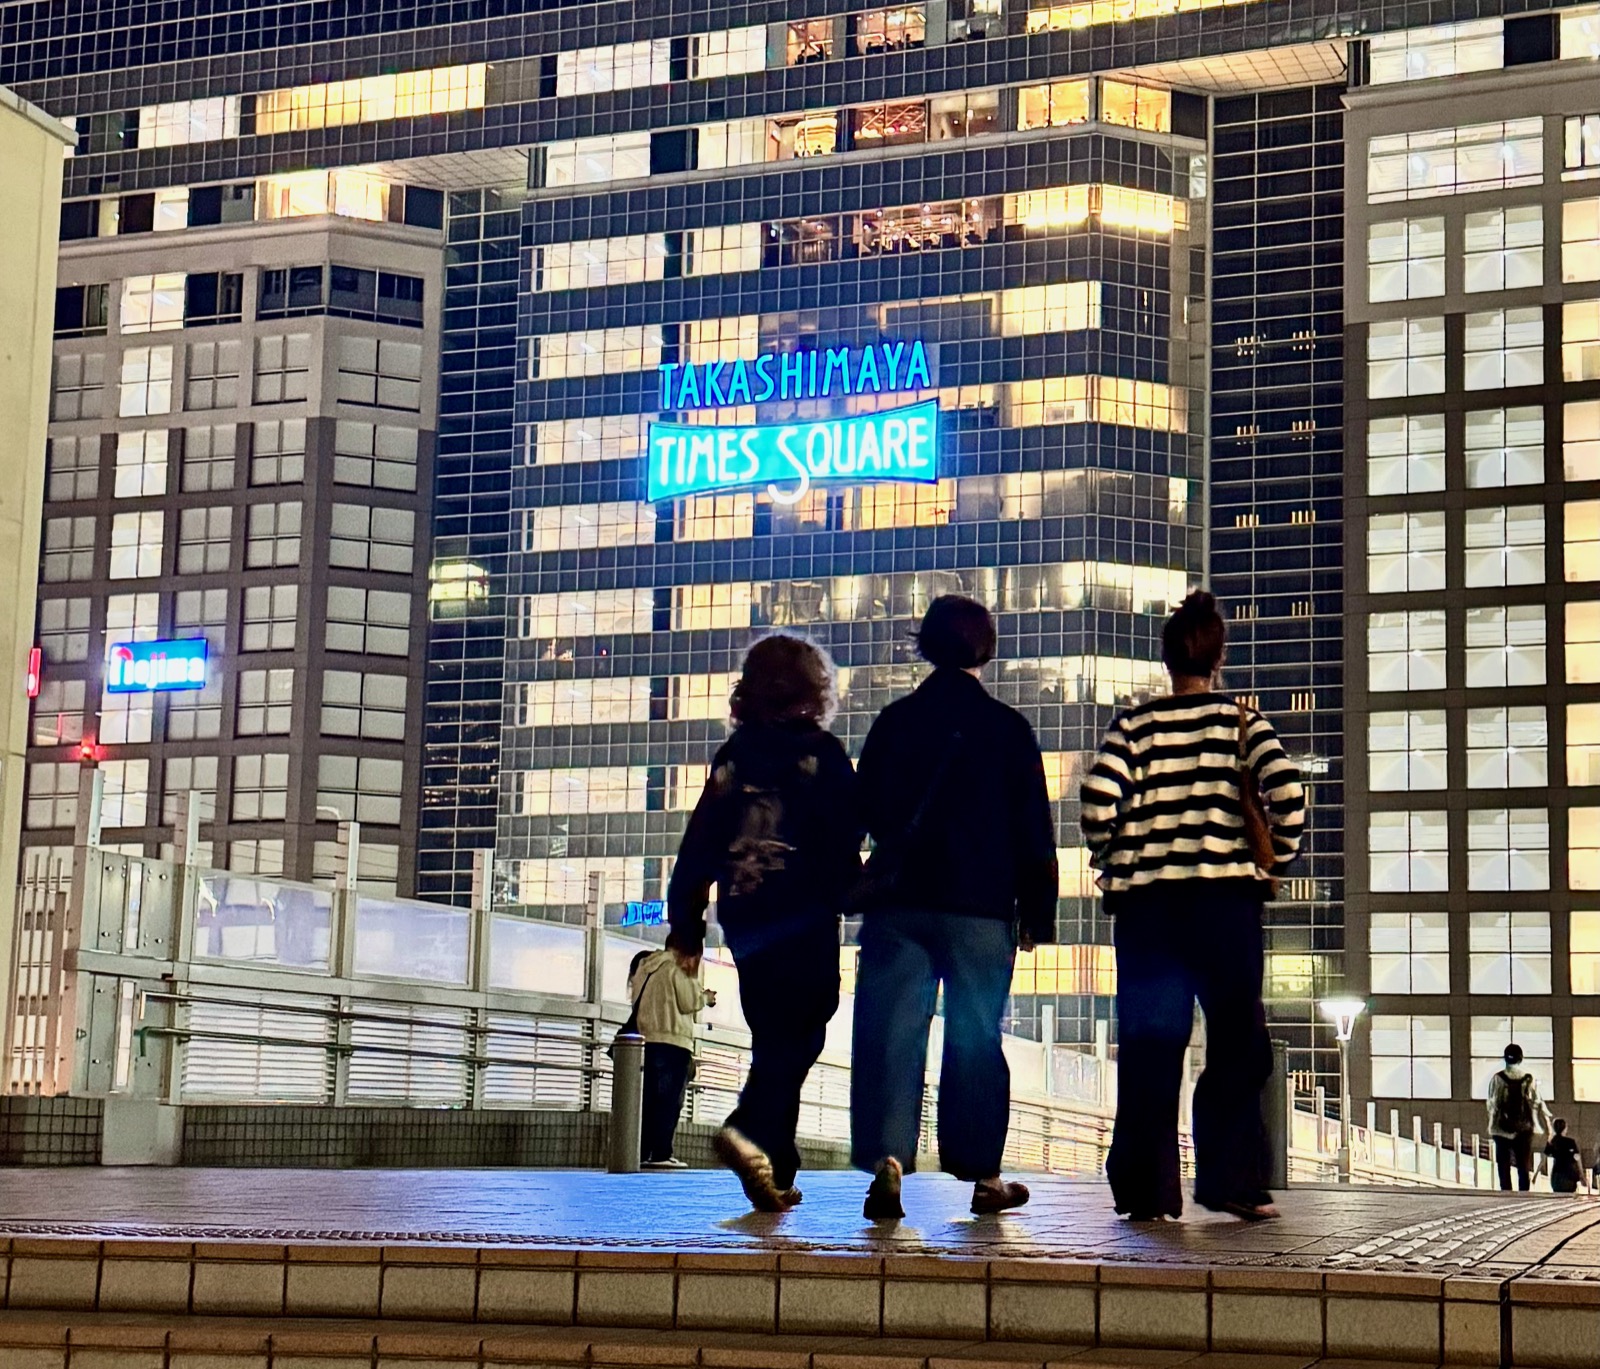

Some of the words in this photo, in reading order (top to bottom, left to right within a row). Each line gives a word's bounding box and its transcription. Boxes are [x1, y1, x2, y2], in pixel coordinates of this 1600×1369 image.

[658, 340, 931, 410] TAKASHIMAYA
[656, 431, 760, 486] TIMES
[767, 418, 929, 505] SQUARE
